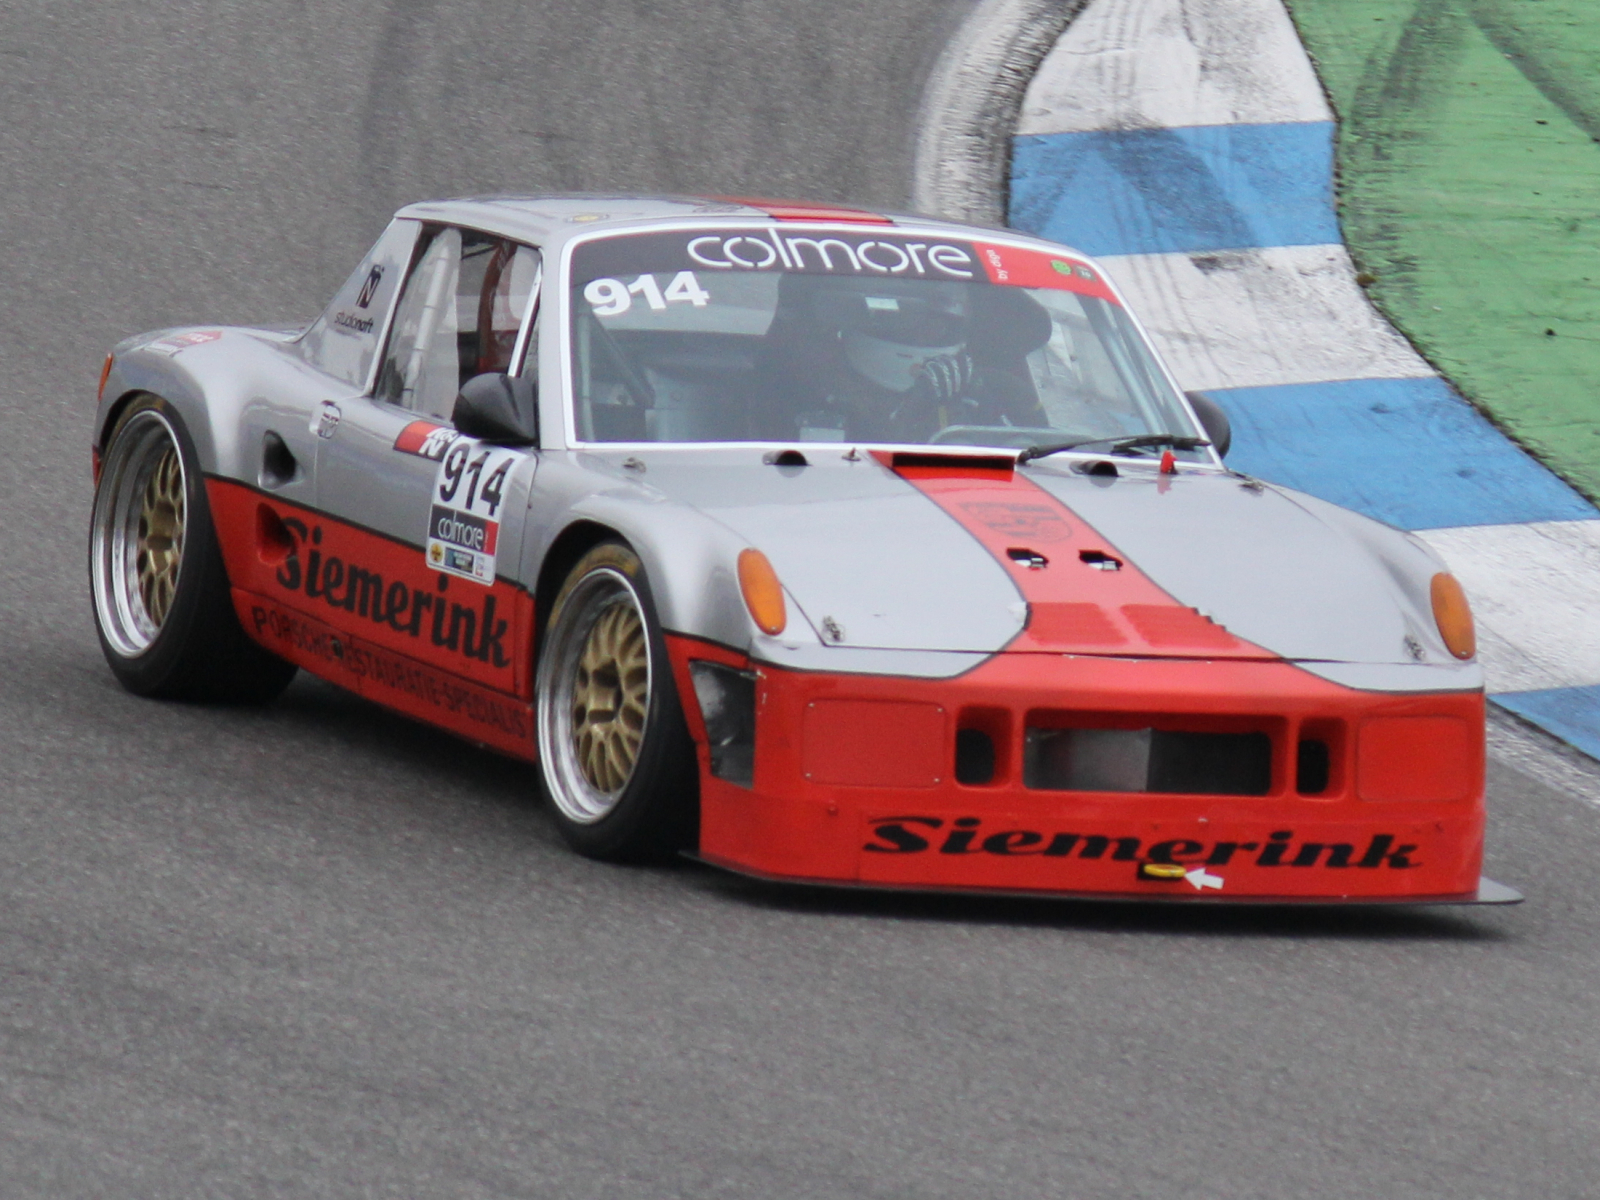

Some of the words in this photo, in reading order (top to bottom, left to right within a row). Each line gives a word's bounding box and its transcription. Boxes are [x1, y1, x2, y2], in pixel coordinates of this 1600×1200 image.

[687, 228, 974, 278] colmore
[584, 270, 710, 317] 914
[439, 442, 515, 517] 914
[437, 510, 485, 549] colmore
[275, 516, 511, 669] Siemerink
[862, 815, 1422, 870] Siemerink
